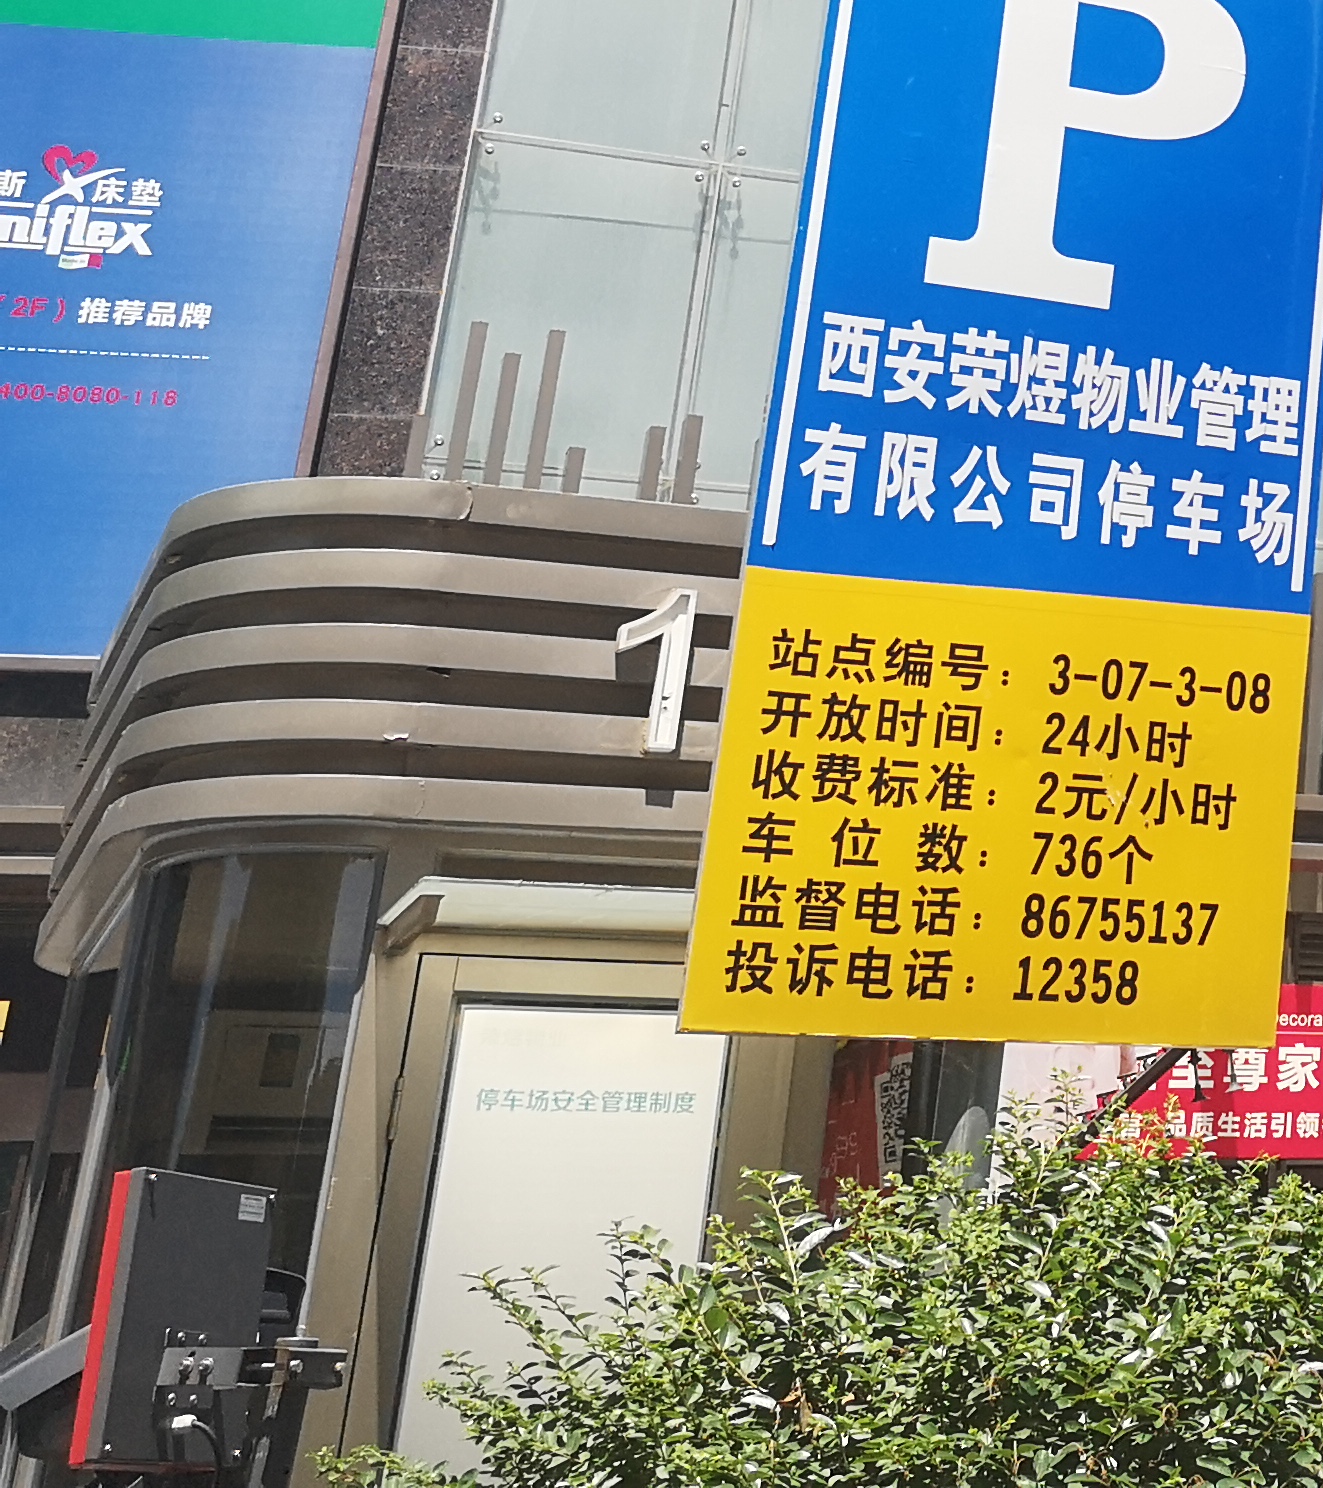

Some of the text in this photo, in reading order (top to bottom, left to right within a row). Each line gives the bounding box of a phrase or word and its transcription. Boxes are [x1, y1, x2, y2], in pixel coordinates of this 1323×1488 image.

[91, 176, 164, 208] 床垫
[77, 297, 213, 329] 推荐品牌
[818, 311, 1301, 456] 西安荣煜物业管理
[799, 422, 1294, 568] 有限公司停车场
[615, 587, 697, 753] 1
[769, 628, 1272, 713] 站点编号： 3-07-3-08
[761, 690, 1193, 769] 开放时间： 24小时
[751, 750, 1238, 831] 收费标准： 2元/小时
[1030, 832, 1154, 886] 736个
[731, 875, 1219, 946] 监督电话： 86755137
[725, 939, 1140, 1006] 投诉电话： 12358
[476, 1087, 697, 1115] 停车场安全管理制度
